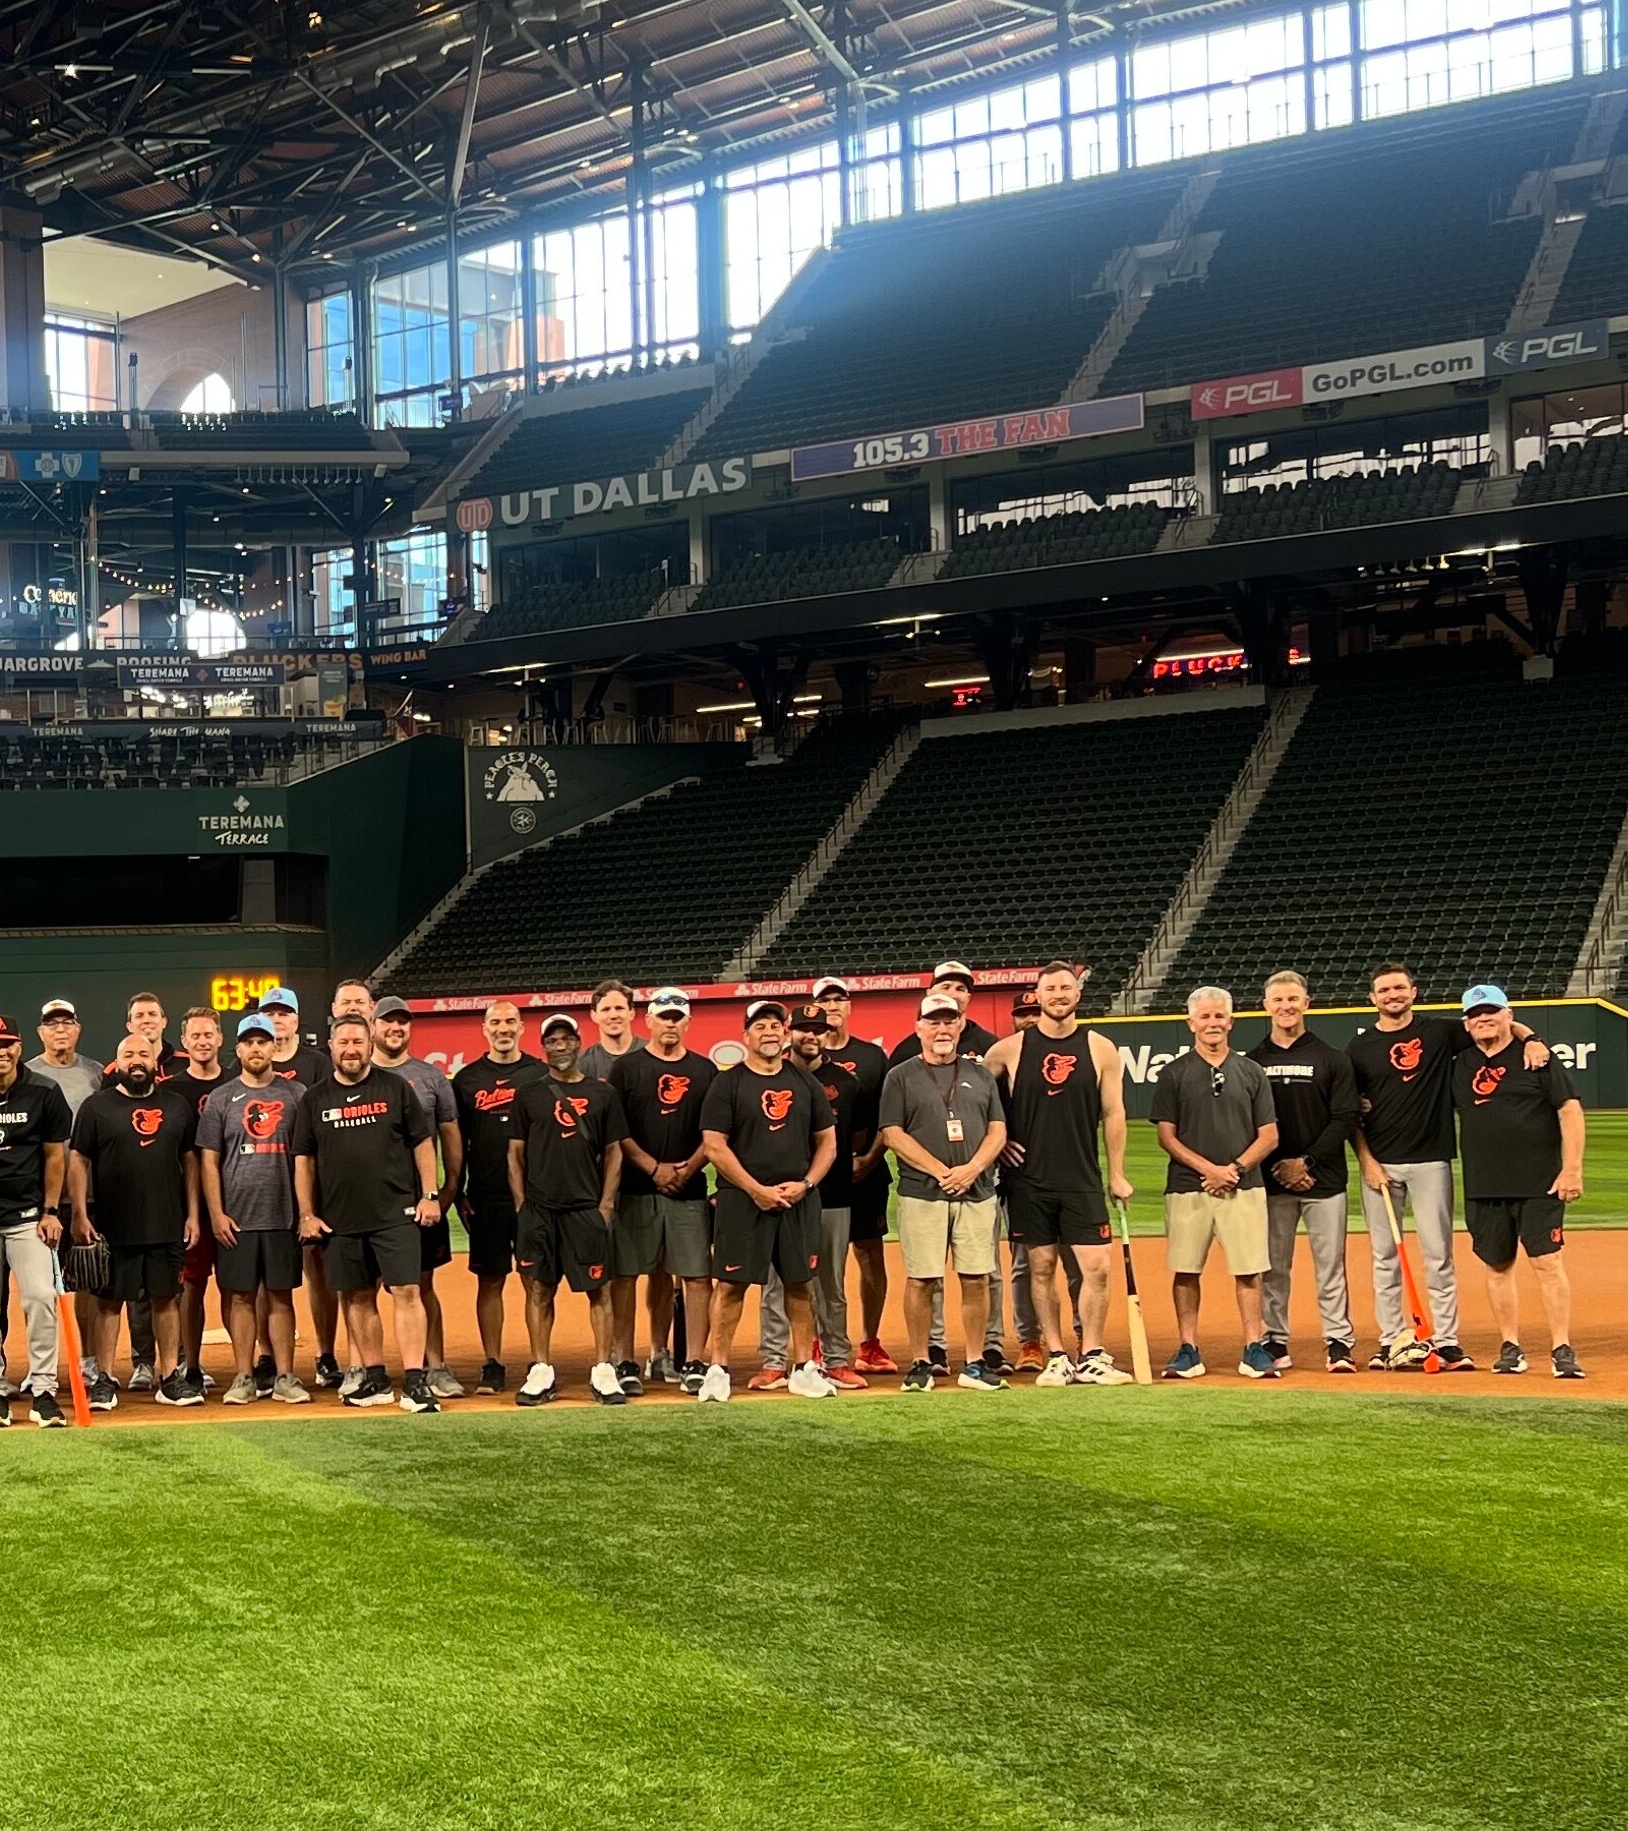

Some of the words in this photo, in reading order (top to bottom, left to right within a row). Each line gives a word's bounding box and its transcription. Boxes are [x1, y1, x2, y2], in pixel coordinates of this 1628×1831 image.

[1521, 331, 1598, 363] PGL
[1312, 353, 1474, 394] GoPGL.com
[1224, 379, 1293, 409] PGL
[852, 433, 929, 469] 105.3
[935, 421, 997, 456] THE
[1003, 409, 1070, 445] FAN
[500, 487, 560, 525] UT
[573, 457, 747, 515] DALLAS
[370, 653, 402, 666] WING
[404, 649, 427, 662] BAR
[130, 667, 190, 679] TEREMANA
[215, 667, 274, 677] TEREMANA
[32, 727, 83, 737] TEREMANA
[306, 723, 356, 733] TEREMANA
[198, 815, 285, 830] TEREMANA
[343, 1102, 388, 1118] ORIOLES
